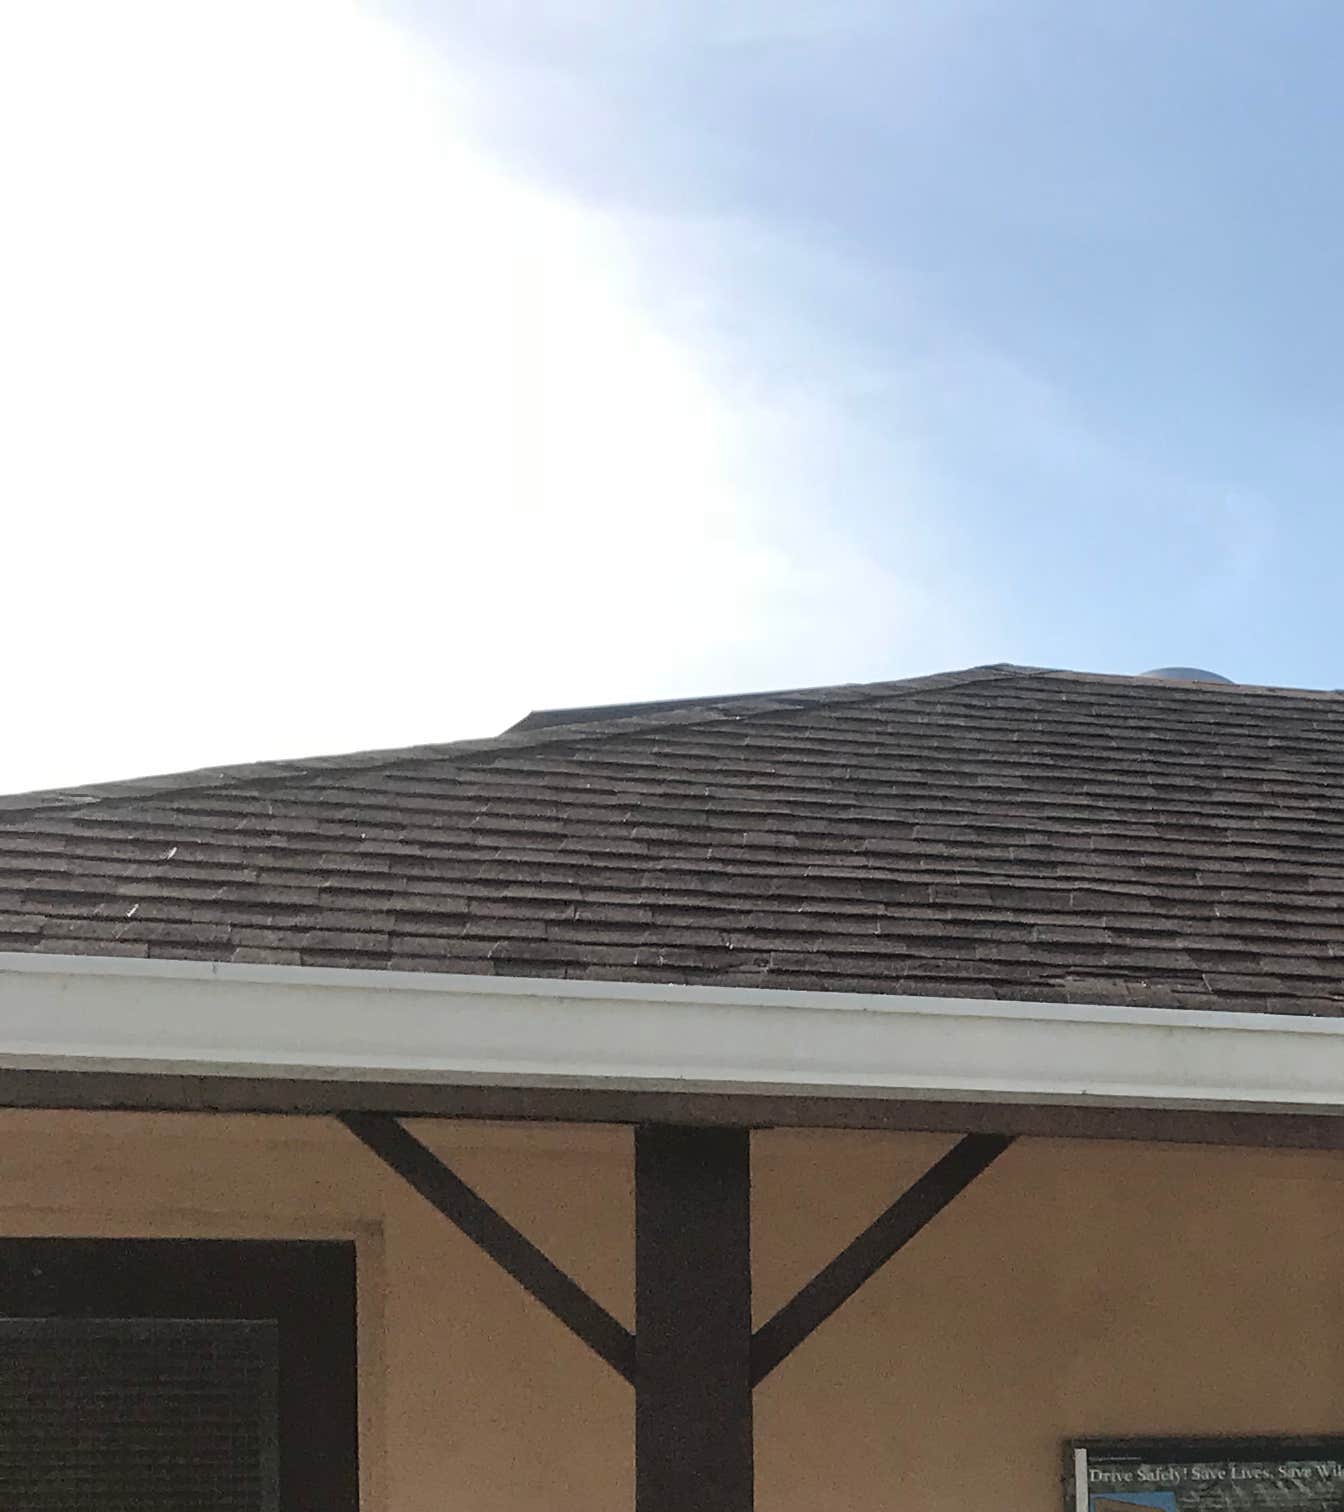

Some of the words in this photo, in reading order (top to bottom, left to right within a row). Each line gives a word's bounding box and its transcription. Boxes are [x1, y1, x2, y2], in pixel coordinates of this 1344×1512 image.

[1089, 1469, 1133, 1482] Drive
[1137, 1467, 1188, 1482] Safely!
[1192, 1467, 1226, 1480] Save
[1278, 1465, 1312, 1479] Save
